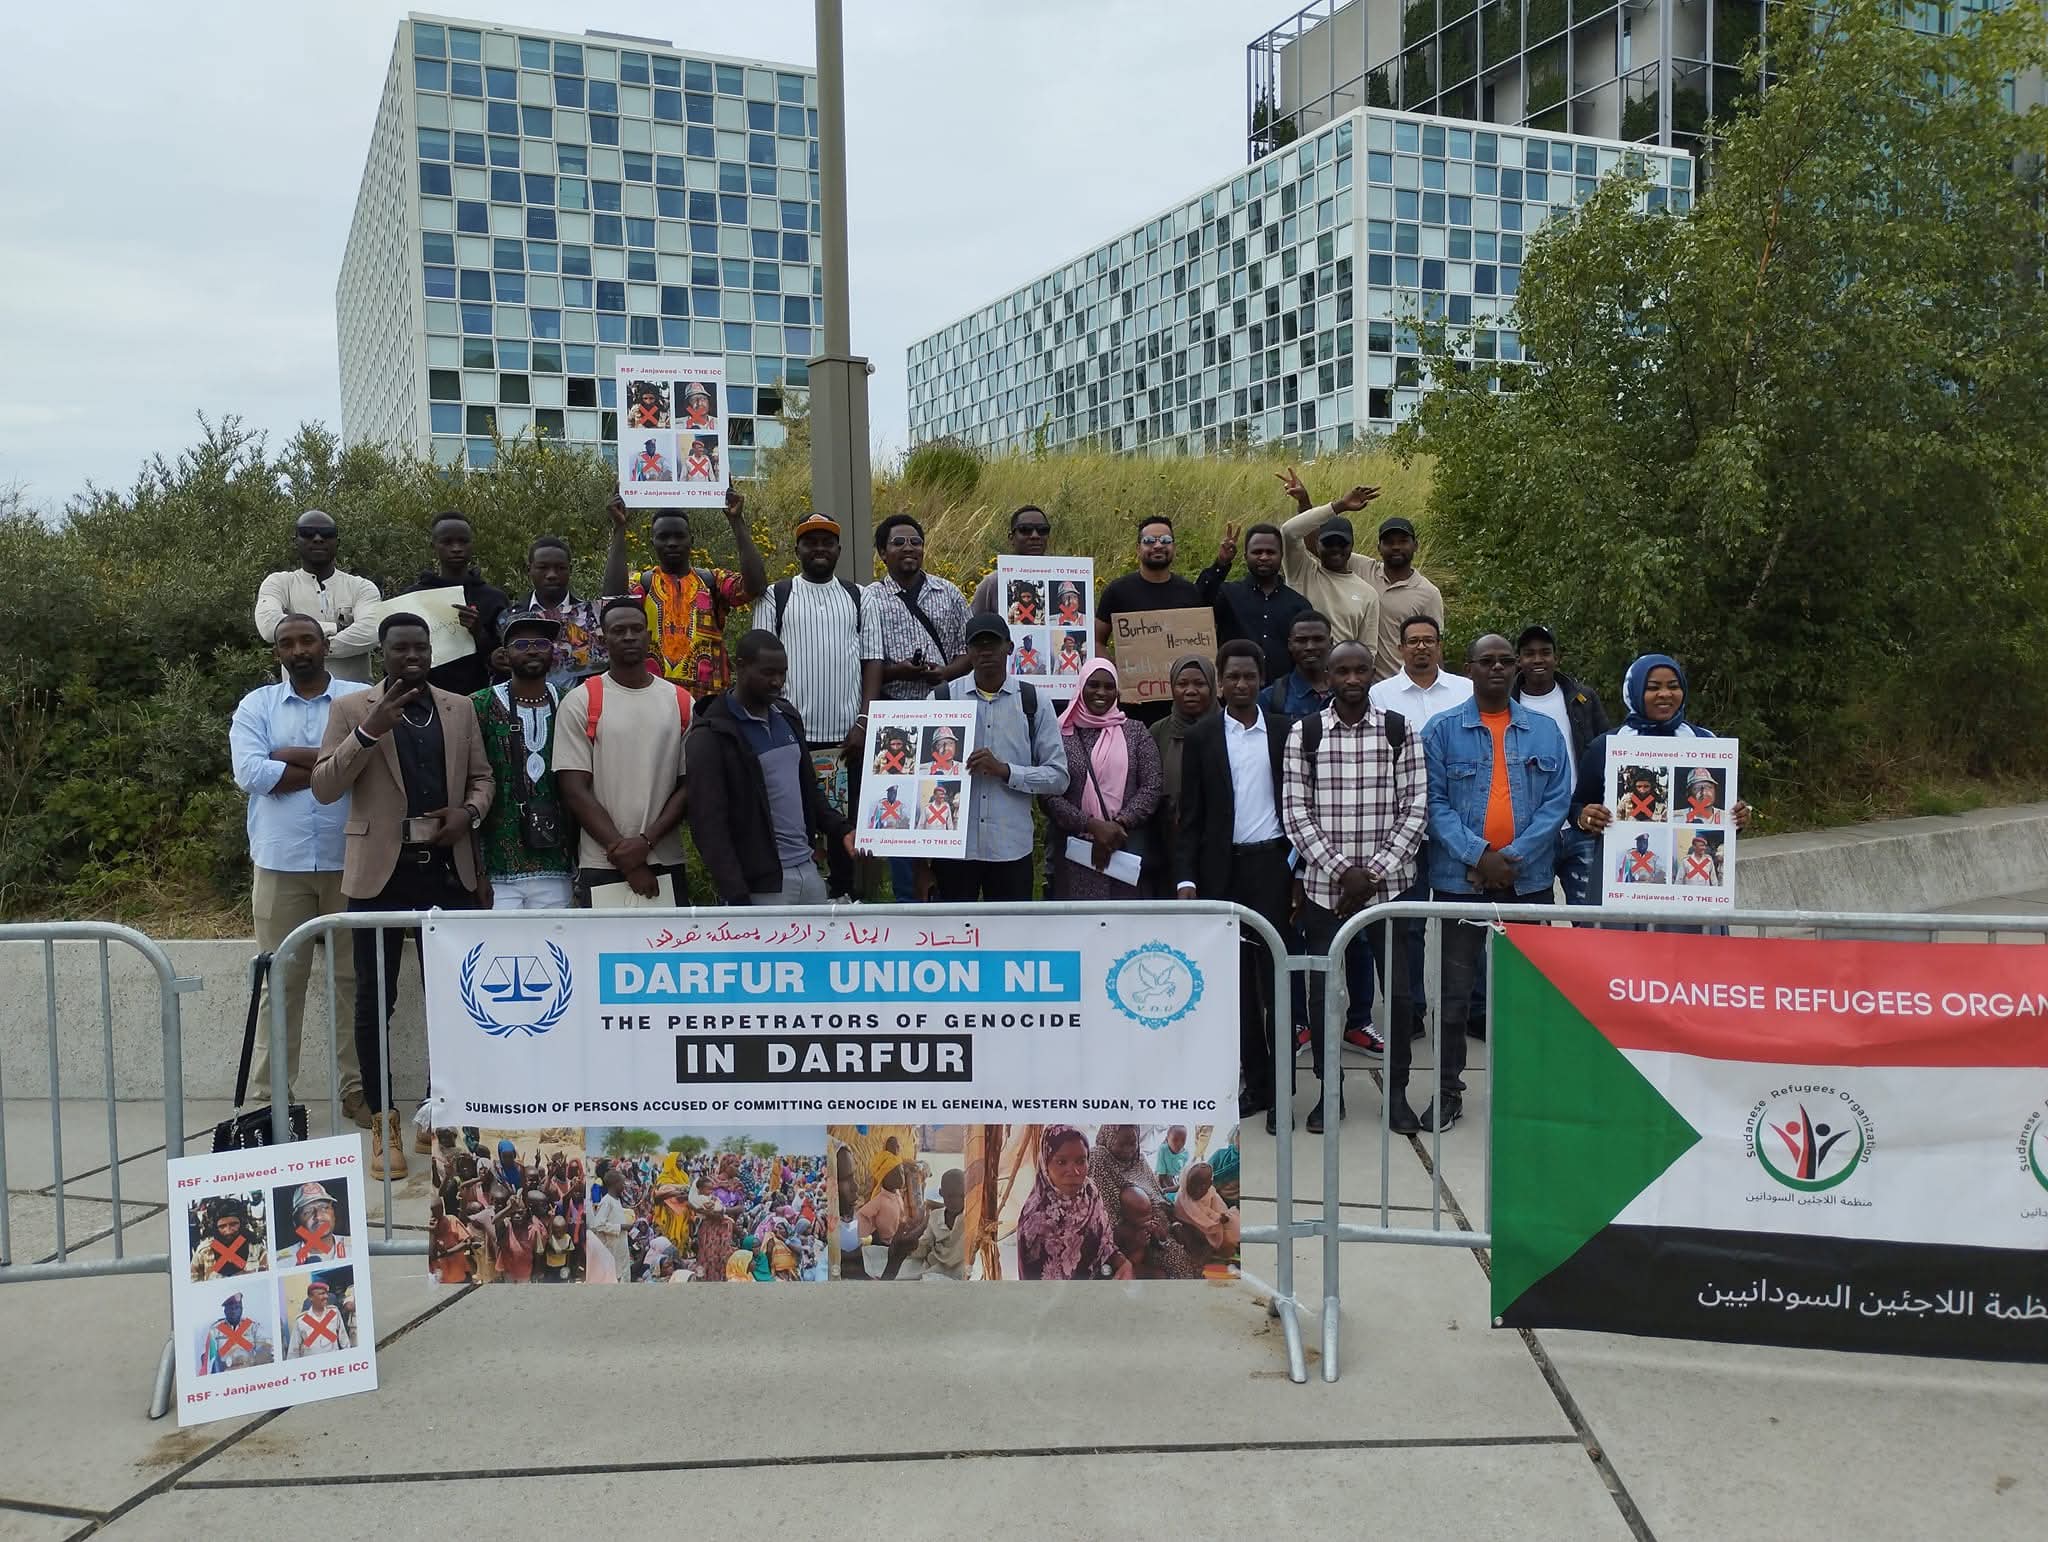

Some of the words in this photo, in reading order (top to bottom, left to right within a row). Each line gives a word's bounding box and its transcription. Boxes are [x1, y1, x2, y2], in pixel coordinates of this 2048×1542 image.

[640, 367, 677, 375] Janjaweed
[1118, 617, 1162, 638] Burhan
[1635, 751, 1679, 760] Janjaweed
[1632, 893, 1675, 902] Janjaweed
[1715, 896, 1730, 904] ICC
[915, 927, 979, 947] اتحاد
[614, 961, 805, 995] DARFUR
[829, 960, 979, 993] UNION
[1005, 960, 1064, 993] NL
[1608, 977, 1765, 1009] SUDANESE
[1775, 986, 1932, 1015] REFUGEES
[601, 1015, 651, 1030] THE
[668, 1014, 879, 1030] PERPETRATORS
[896, 1014, 928, 1028] OF
[944, 1013, 1081, 1028] GENOCIDE
[687, 1043, 735, 1074] IN
[768, 1042, 965, 1074] DARFUR
[465, 1101, 548, 1114] SUBMISSION
[552, 1101, 570, 1112] OF
[574, 1100, 639, 1112] PERSONS
[642, 1100, 708, 1112] ACCUSED
[711, 1100, 730, 1111] OF
[733, 1099, 823, 1111] COMMITTING
[827, 1099, 898, 1110] GENOCIDE
[902, 1099, 917, 1110] IN
[921, 1099, 939, 1110] EL
[941, 1099, 1008, 1112] GENEINA,
[1011, 1099, 1078, 1110] WESTERN
[1082, 1099, 1134, 1112] SUDAN,
[1138, 1099, 1157, 1110] TO
[1161, 1099, 1189, 1110] THE
[1193, 1099, 1217, 1111] ICC
[1743, 1099, 1767, 1158] Sudanese
[1771, 1084, 1836, 1099] Refugees
[1839, 1091, 1875, 1164] Organization
[2016, 1111, 2041, 1172] Sudanese
[177, 1177, 201, 1188] RSF
[212, 1166, 277, 1184] Janjaweed
[287, 1162, 304, 1173] TO
[308, 1158, 332, 1169] THE
[335, 1155, 356, 1165] ICC
[1840, 1196, 1873, 1207] منظمة
[1697, 1278, 1851, 1310] السودانيين
[1859, 1289, 1975, 1318] اللاجئين
[187, 1391, 211, 1403] RSF
[223, 1376, 289, 1397] Janjaweed
[300, 1371, 317, 1382] TO
[320, 1366, 345, 1378] THE
[349, 1361, 369, 1373] ICC
